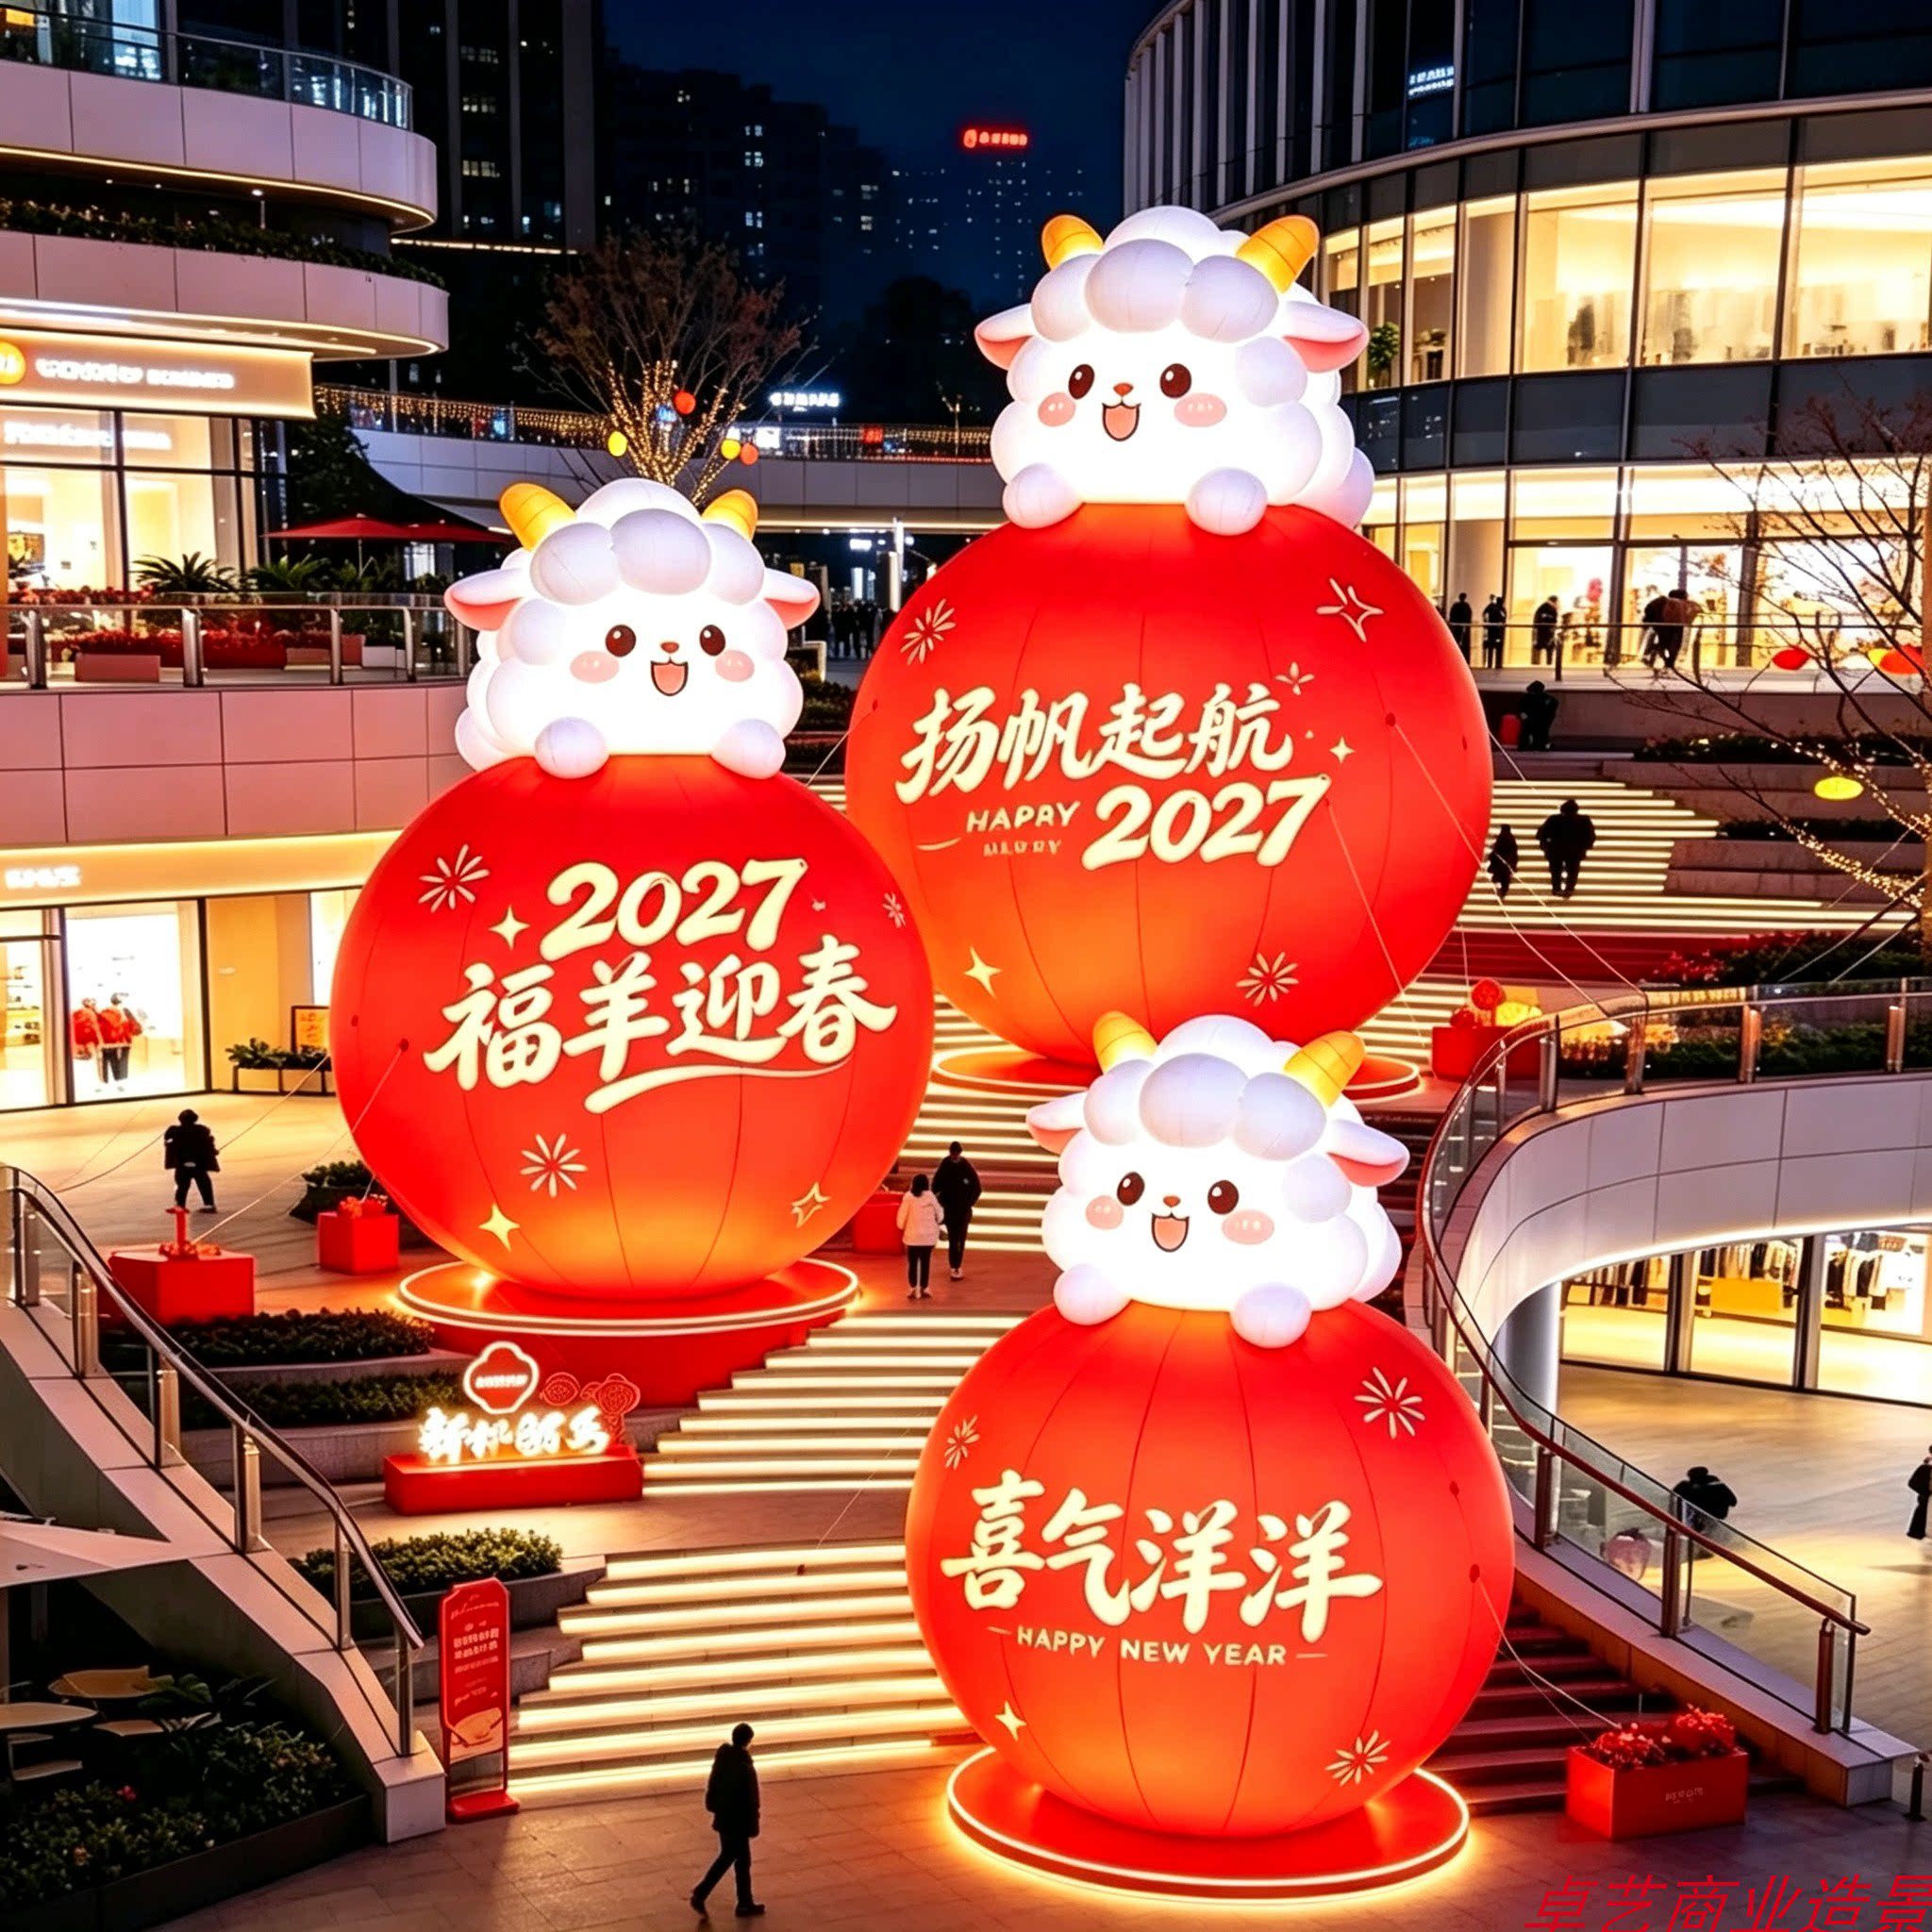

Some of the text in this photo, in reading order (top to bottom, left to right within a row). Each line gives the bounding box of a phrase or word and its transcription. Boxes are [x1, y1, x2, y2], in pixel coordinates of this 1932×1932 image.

[895, 682, 1293, 805] 扬帆起航
[1081, 774, 1332, 871] 2027
[540, 858, 808, 961] 2027
[423, 934, 898, 1091] 福羊迎春
[940, 1469, 1384, 1643] 喜气洋洋
[1017, 1624, 1287, 1666] HAPPY NEW YEAR
